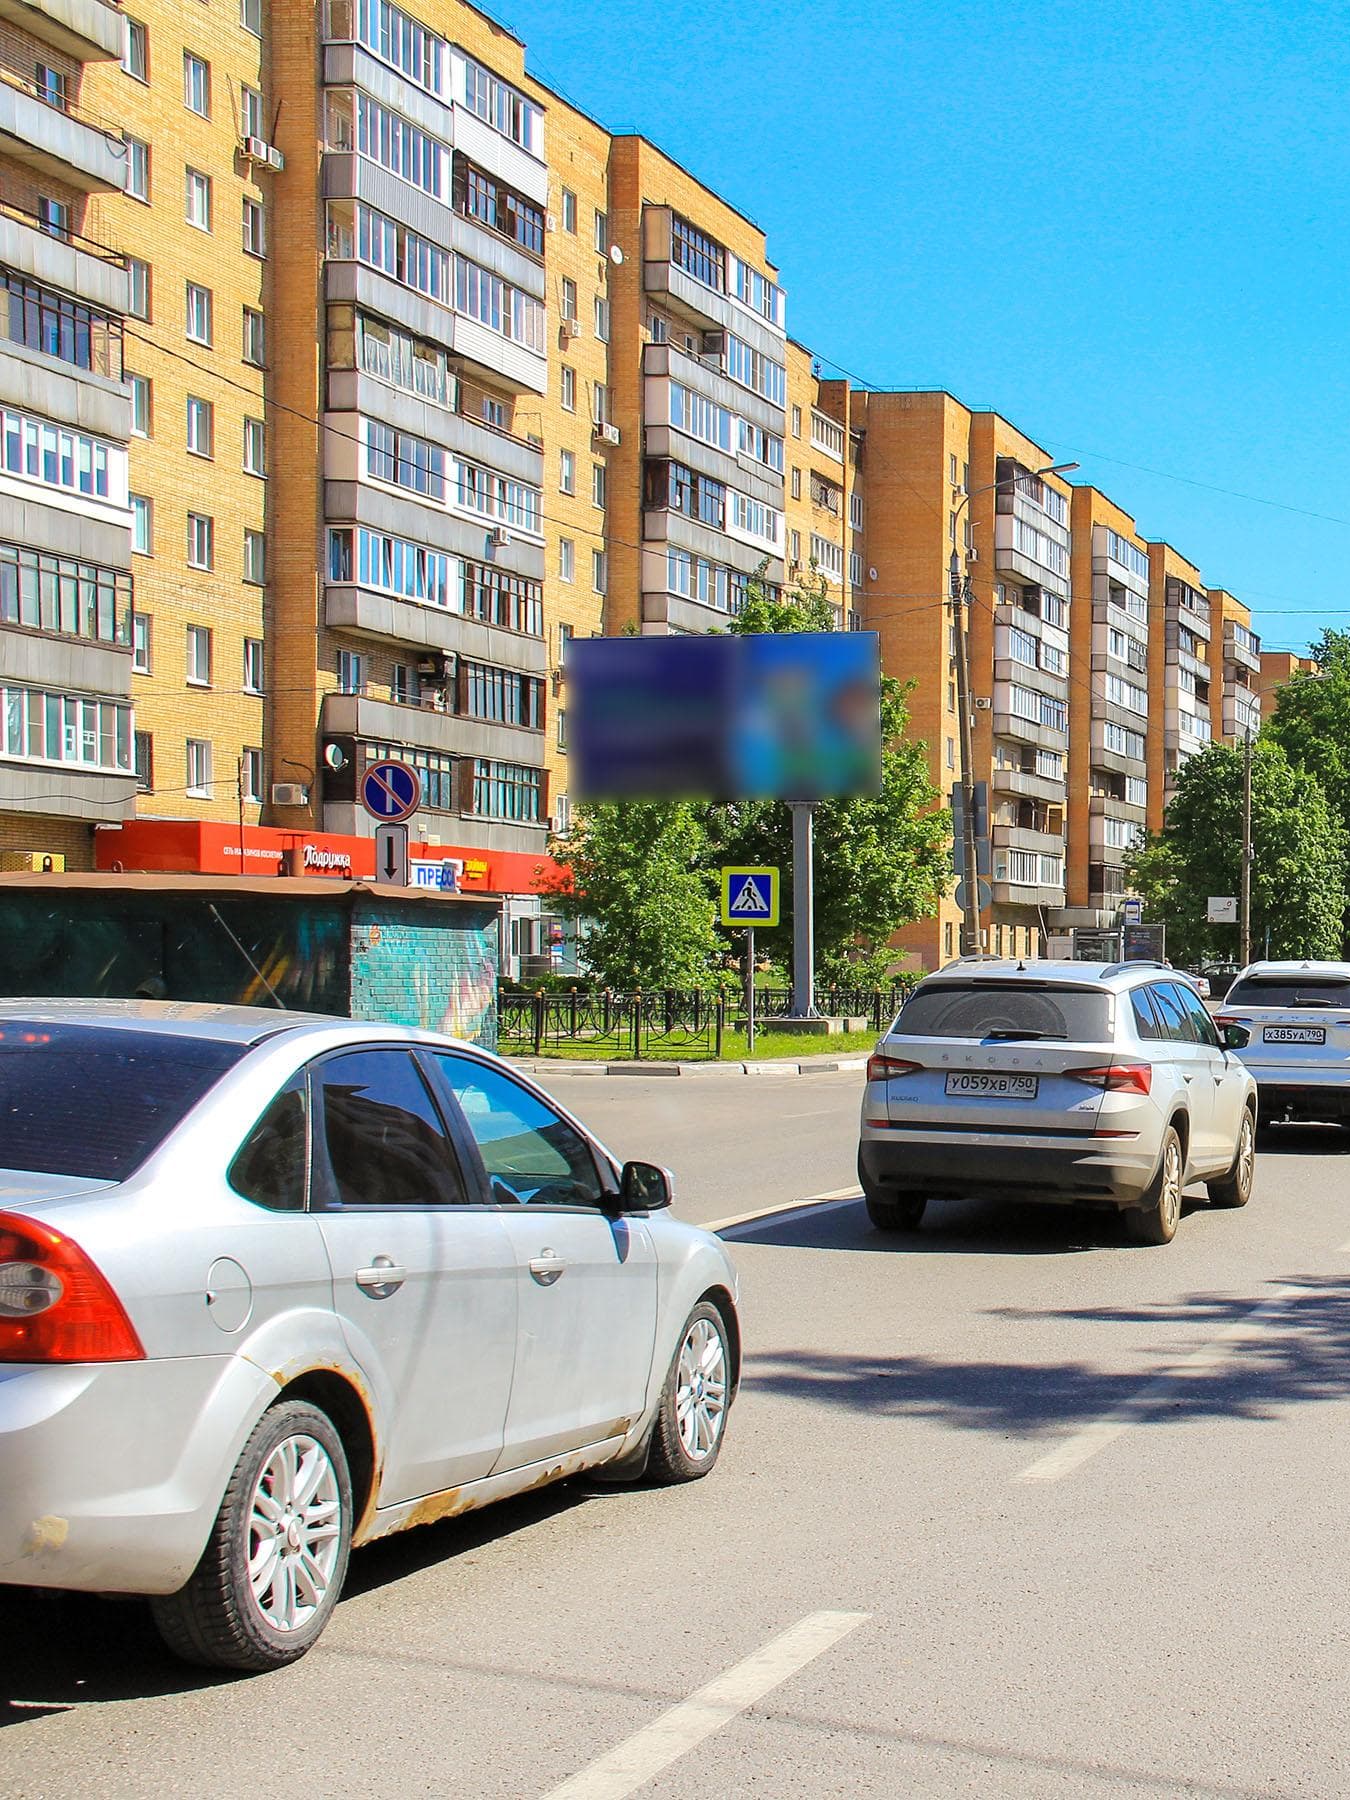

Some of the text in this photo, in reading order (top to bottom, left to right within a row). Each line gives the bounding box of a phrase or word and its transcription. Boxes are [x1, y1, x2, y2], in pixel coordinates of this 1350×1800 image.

[303, 845, 350, 868] Подружка
[1267, 1029, 1322, 1040] Х385УА 790
[951, 1075, 1033, 1091] У059ХВ 750
